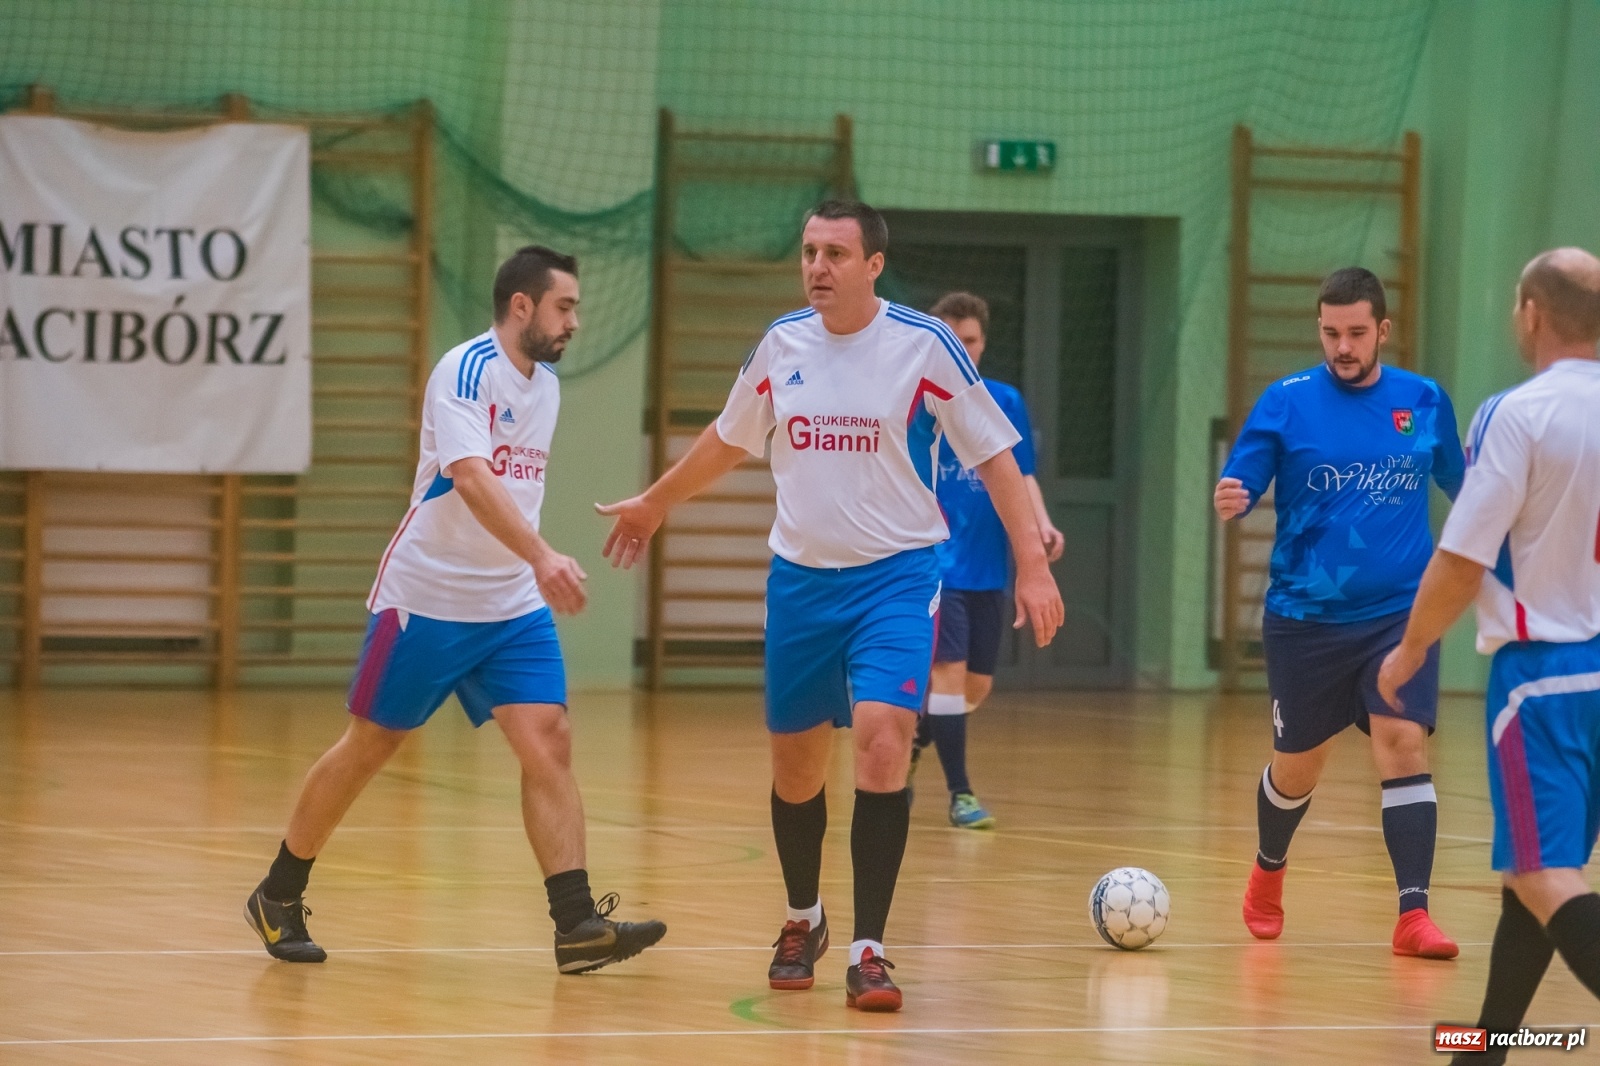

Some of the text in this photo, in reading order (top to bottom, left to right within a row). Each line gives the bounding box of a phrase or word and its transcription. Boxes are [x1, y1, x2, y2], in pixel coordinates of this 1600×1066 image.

[0, 221, 247, 281] MIASTO
[788, 416, 880, 453] Gianni
[813, 415, 880, 428] CUKIERNIA
[1307, 462, 1423, 492] Wiktoria
[1273, 699, 1284, 738] 4
